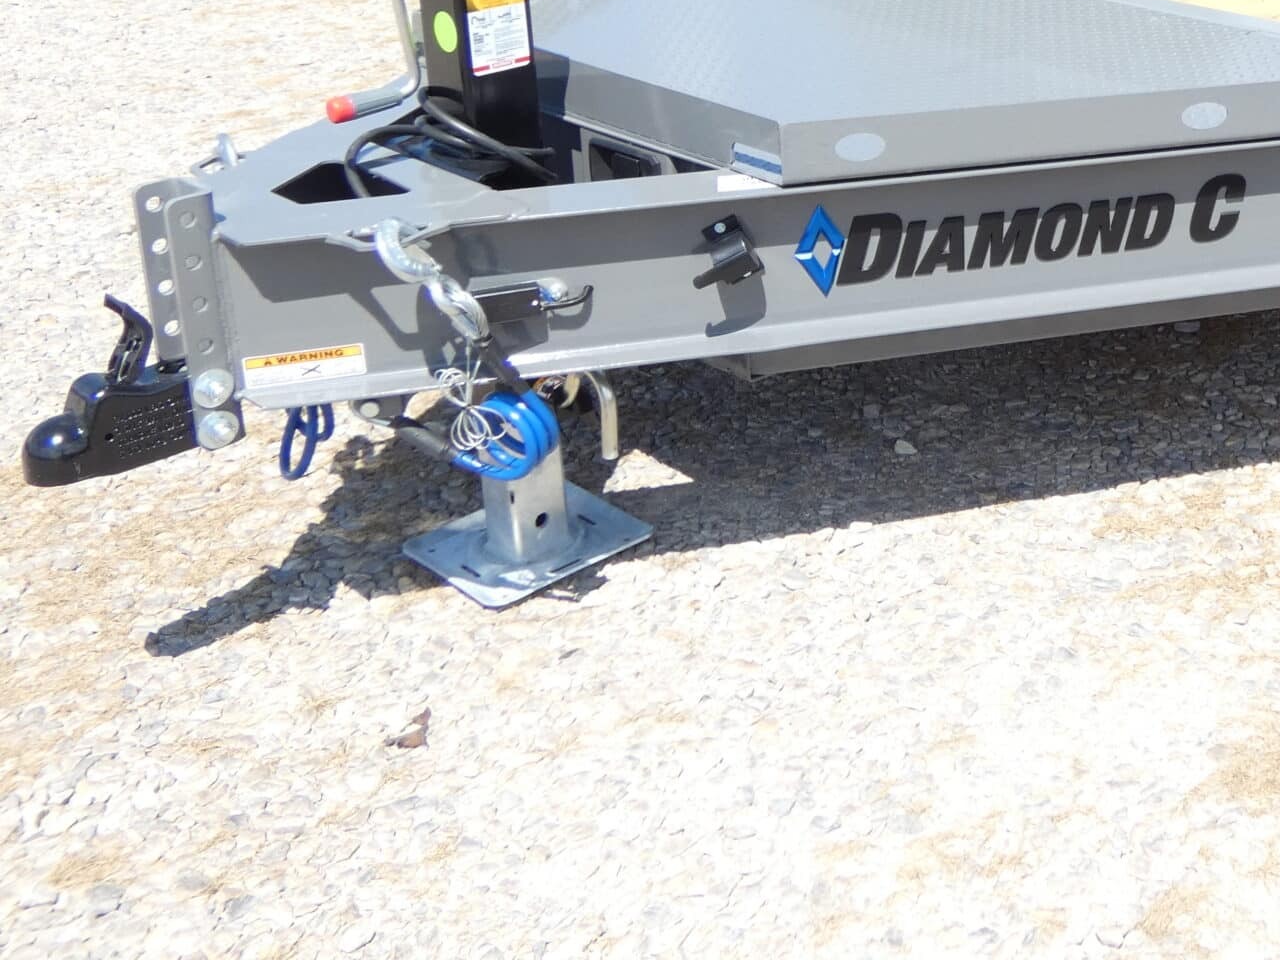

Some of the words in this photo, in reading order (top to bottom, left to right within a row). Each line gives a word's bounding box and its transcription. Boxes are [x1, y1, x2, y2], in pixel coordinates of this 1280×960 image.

[836, 191, 1175, 287] DIAMOND
[1189, 173, 1247, 244] C
[276, 349, 344, 363] WARNING
